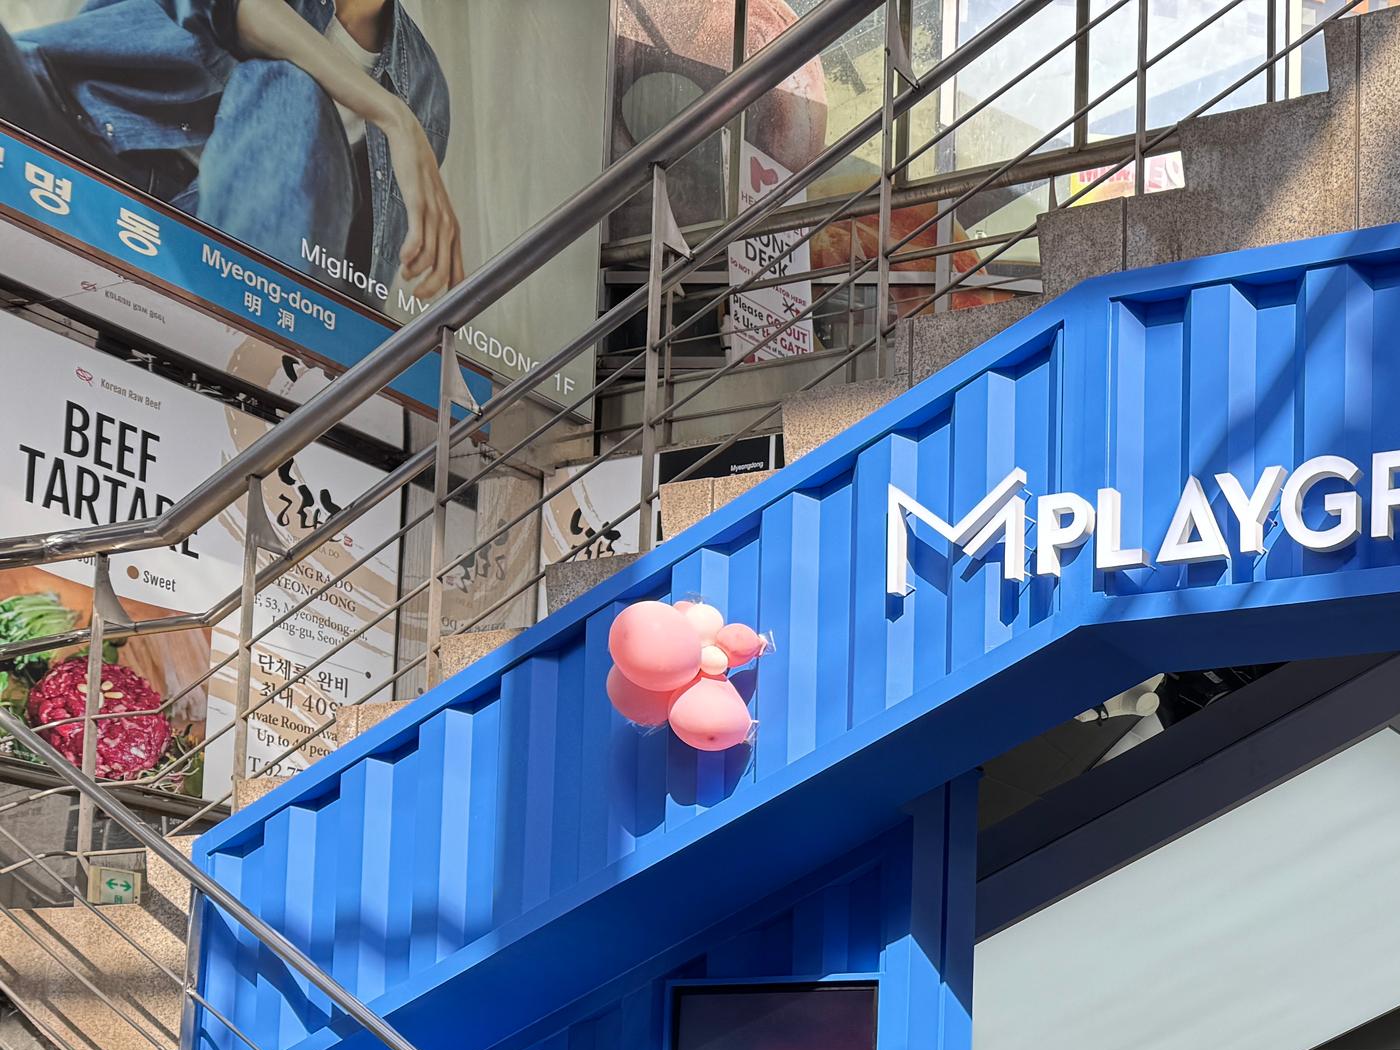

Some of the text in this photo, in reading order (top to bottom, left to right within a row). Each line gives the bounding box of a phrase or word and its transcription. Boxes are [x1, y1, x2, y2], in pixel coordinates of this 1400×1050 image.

[202, 243, 336, 331] Myeong-dong
[244, 291, 296, 332] 明洞
[301, 237, 576, 395] Migliore MYNGDON 1F
[100, 378, 161, 410] Korean Raw Beef
[63, 399, 160, 483] BEEF
[730, 461, 764, 472] Myeongdong
[143, 570, 177, 593] Sweet
[272, 576, 357, 613] YEONDONG
[265, 597, 280, 612] 53,
[316, 671, 348, 698] 완비
[252, 711, 315, 735] ivate Room
[256, 728, 274, 746] Up
[278, 734, 290, 747] to
[309, 745, 334, 758] peo
[248, 756, 261, 773] T
